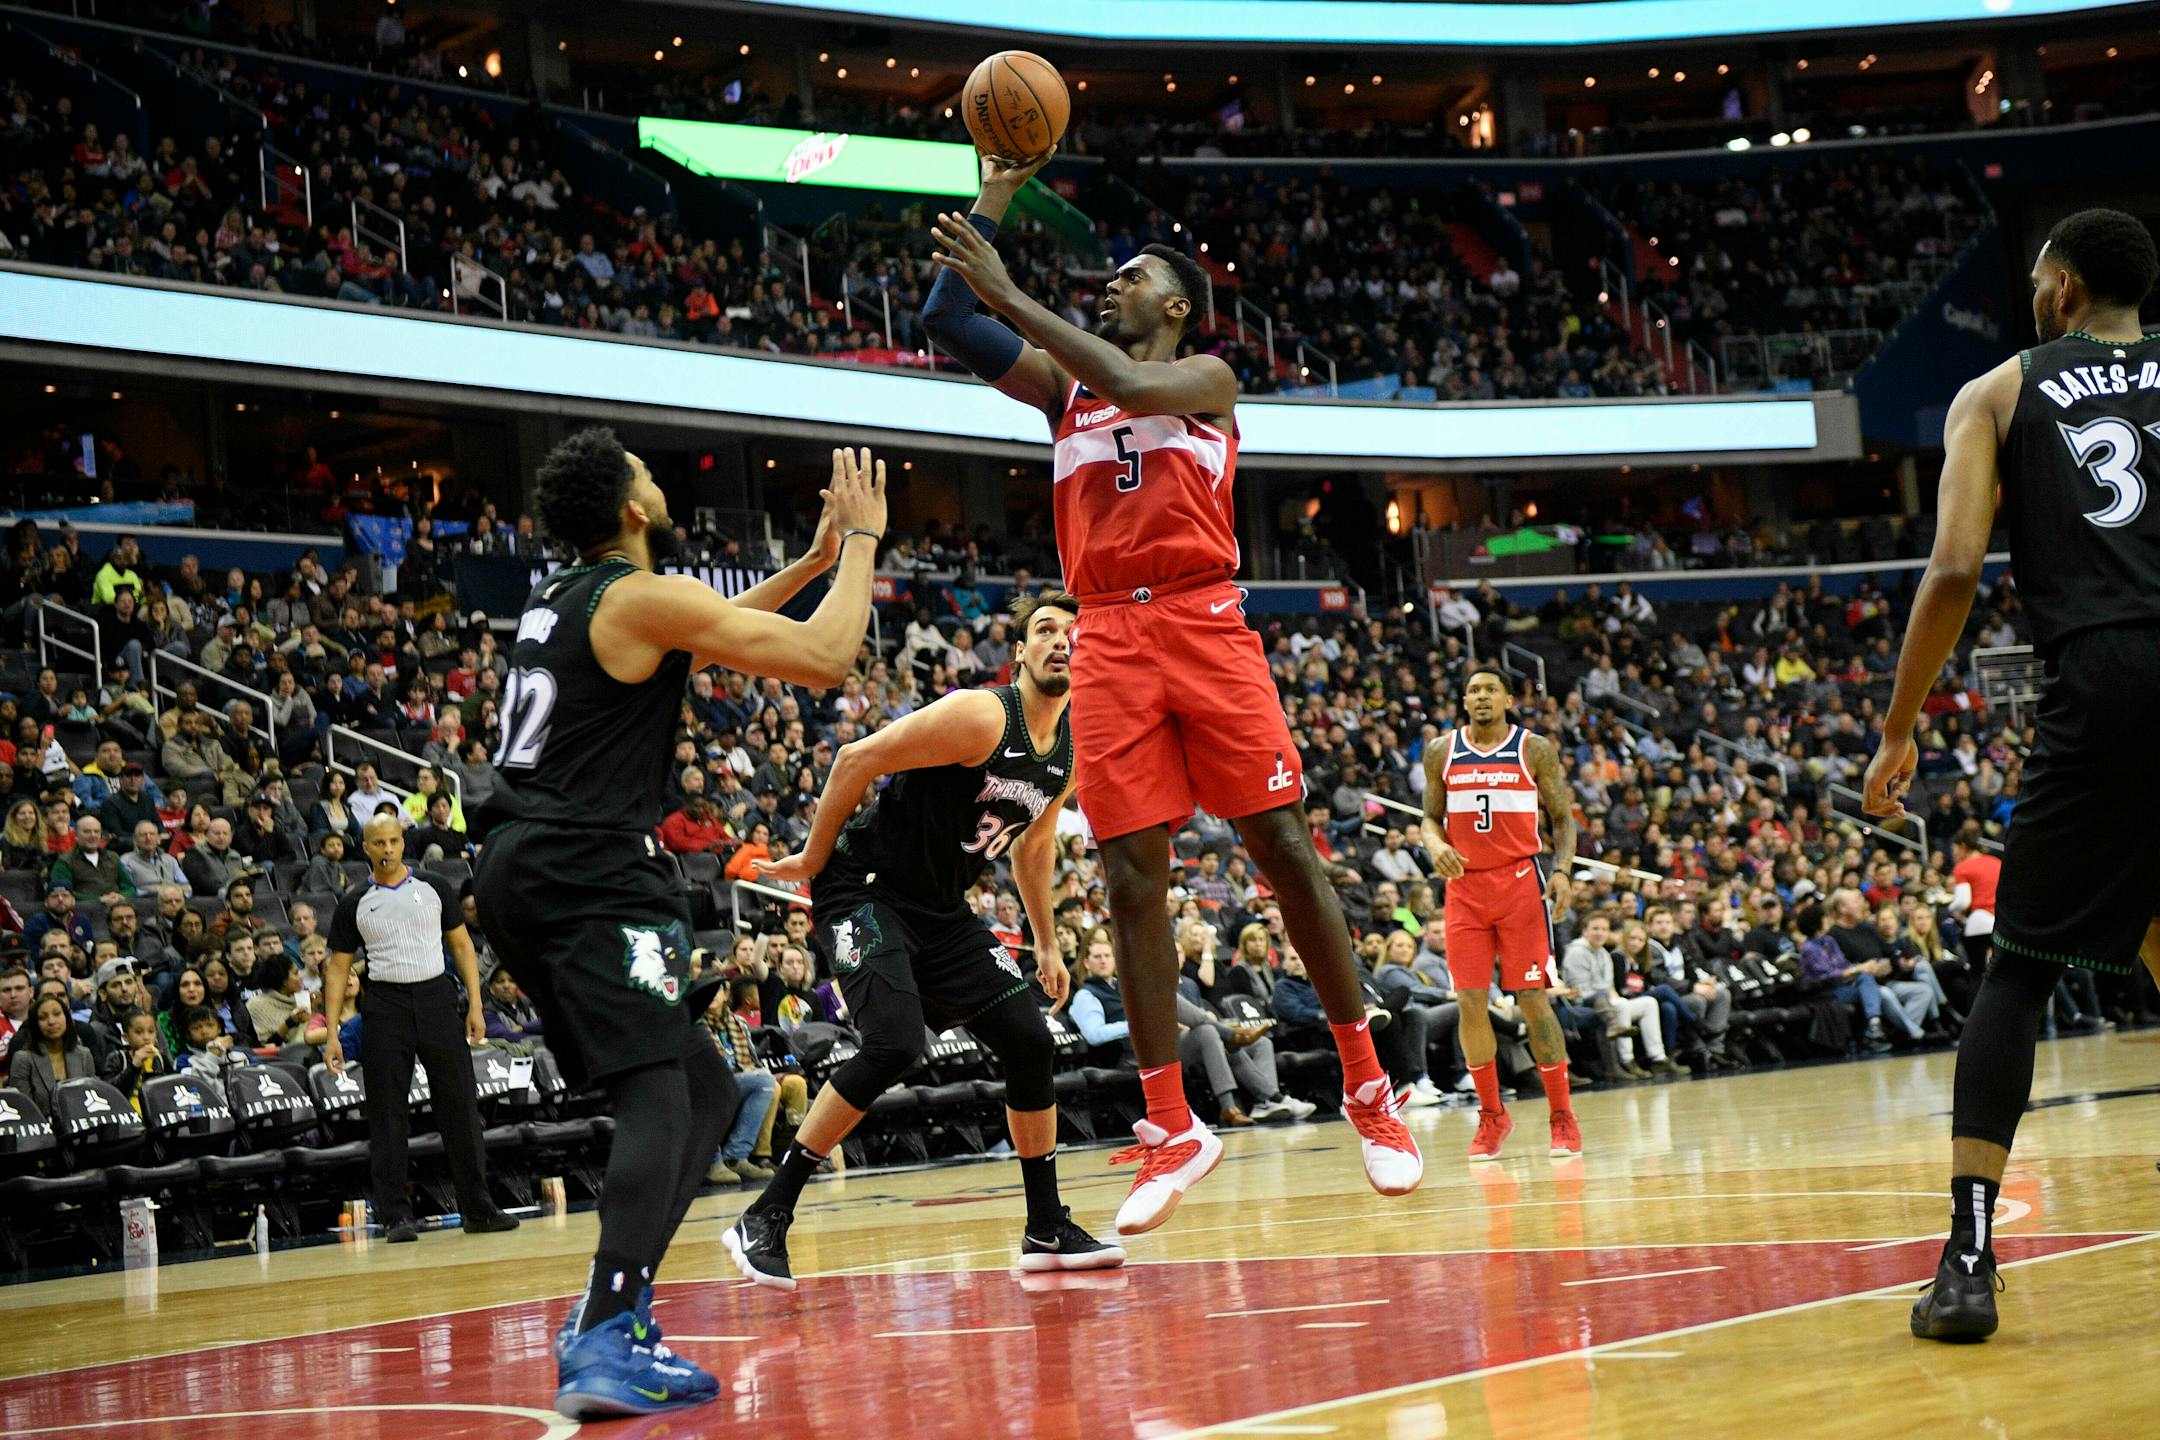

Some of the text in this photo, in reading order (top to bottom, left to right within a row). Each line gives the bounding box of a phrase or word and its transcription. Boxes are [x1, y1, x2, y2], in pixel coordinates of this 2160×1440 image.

[2038, 362, 2160, 408] BATES-D
[1112, 426, 1141, 492] 5
[2056, 416, 2160, 528] 3
[664, 565, 768, 600] MILY
[1474, 793, 1493, 832] 3
[960, 810, 1027, 861] 36
[159, 1105, 232, 1127] JETNX
[246, 1095, 314, 1118] JETLINX
